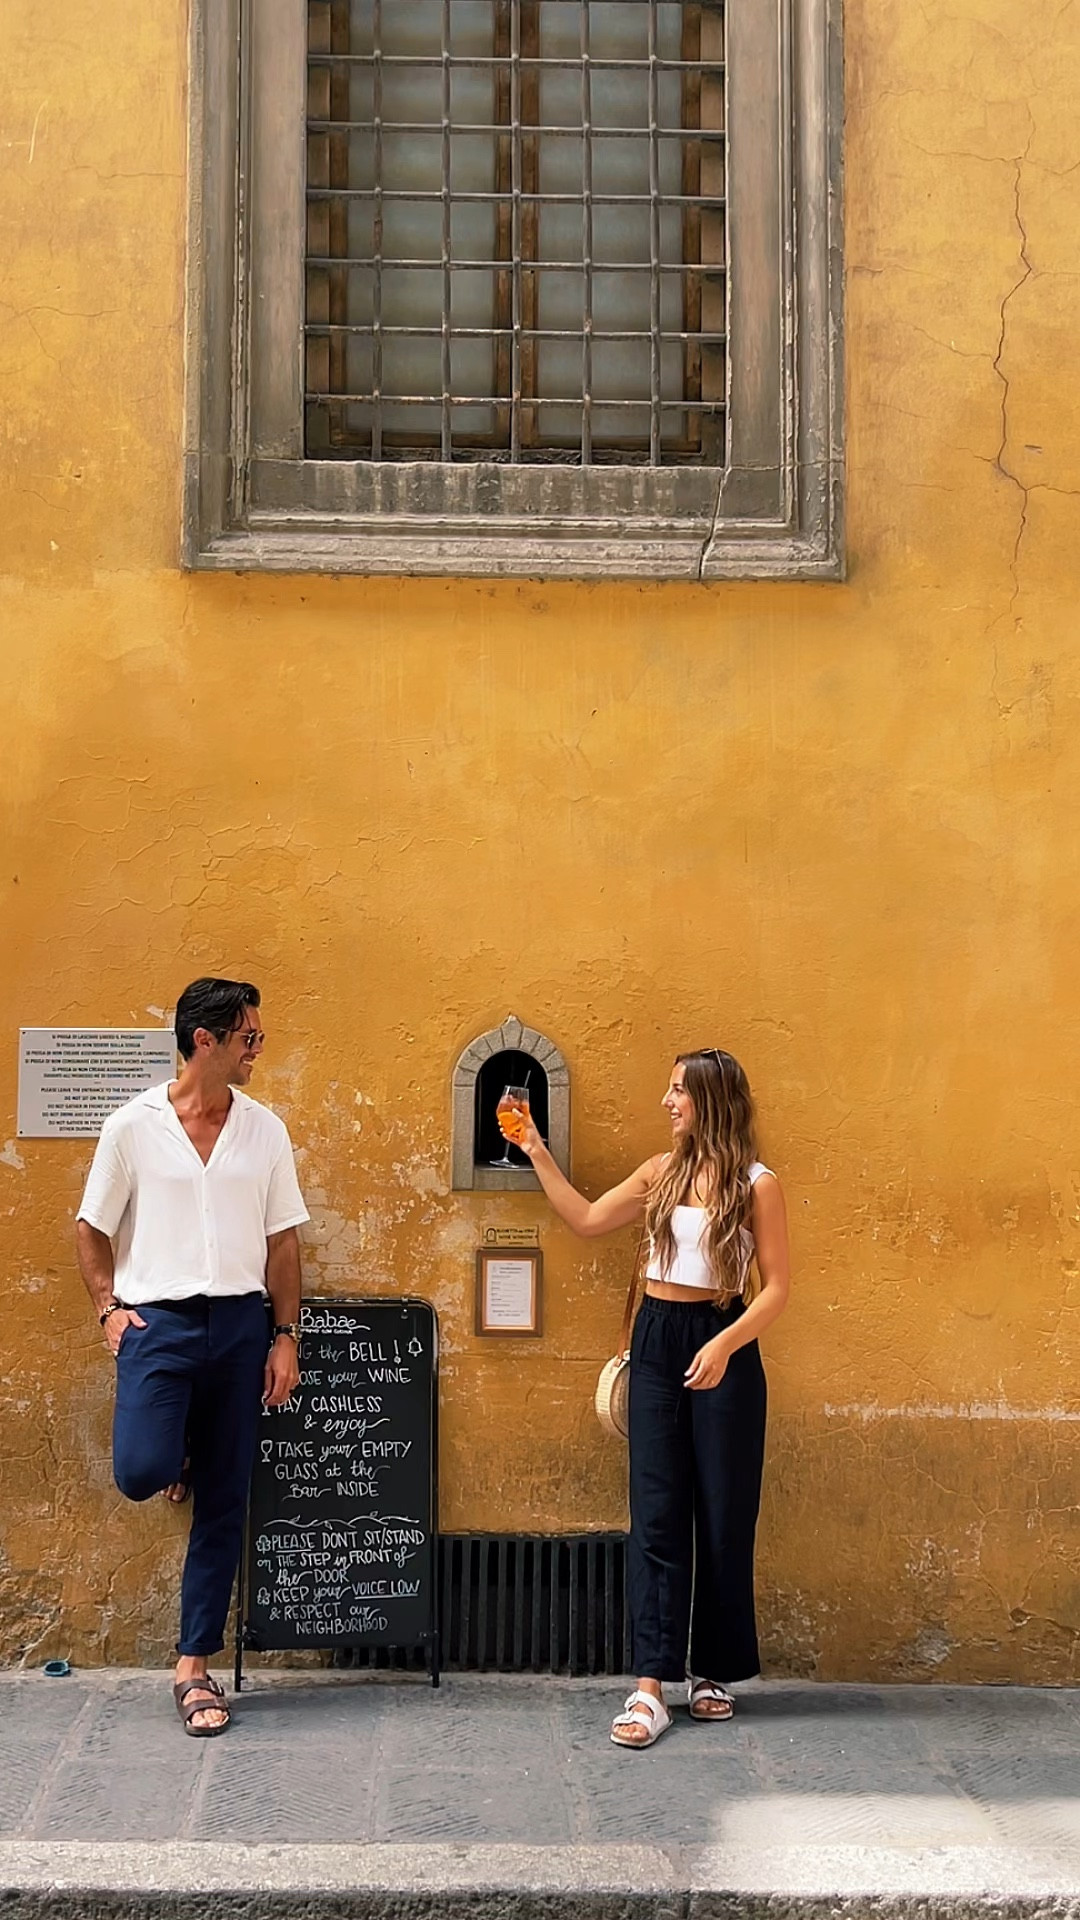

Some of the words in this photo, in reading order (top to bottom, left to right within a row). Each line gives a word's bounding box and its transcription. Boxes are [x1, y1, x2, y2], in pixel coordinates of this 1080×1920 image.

[300, 1307, 371, 1331] Babae
[318, 1343, 346, 1362] the
[328, 1370, 367, 1389] your
[367, 1367, 412, 1384] WINE
[311, 1395, 382, 1413] CASHLESS
[304, 1414, 317, 1430] &
[322, 1417, 391, 1439] enjoy
[276, 1441, 314, 1458] TAKE
[319, 1443, 358, 1462] your
[362, 1440, 412, 1458] EMPTY
[275, 1462, 319, 1480] GLASS
[325, 1462, 342, 1478] at
[350, 1460, 391, 1479] the
[282, 1483, 332, 1501] Bar
[336, 1481, 380, 1498] INSIDE
[272, 1532, 316, 1550] PLEASE
[257, 1559, 274, 1573] on
[276, 1554, 297, 1568] THE
[300, 1552, 332, 1566] STEP
[333, 1553, 351, 1570] in
[350, 1550, 392, 1564] FRONT
[394, 1546, 416, 1568] of
[276, 1568, 313, 1586] the
[314, 1569, 350, 1584] DOOR
[273, 1586, 309, 1603] KEEP
[313, 1586, 351, 1602] your
[352, 1580, 387, 1596] VOICE
[391, 1578, 421, 1596] LOW
[269, 1607, 282, 1621] &
[284, 1602, 341, 1621] RESPECT
[350, 1606, 381, 1620] our
